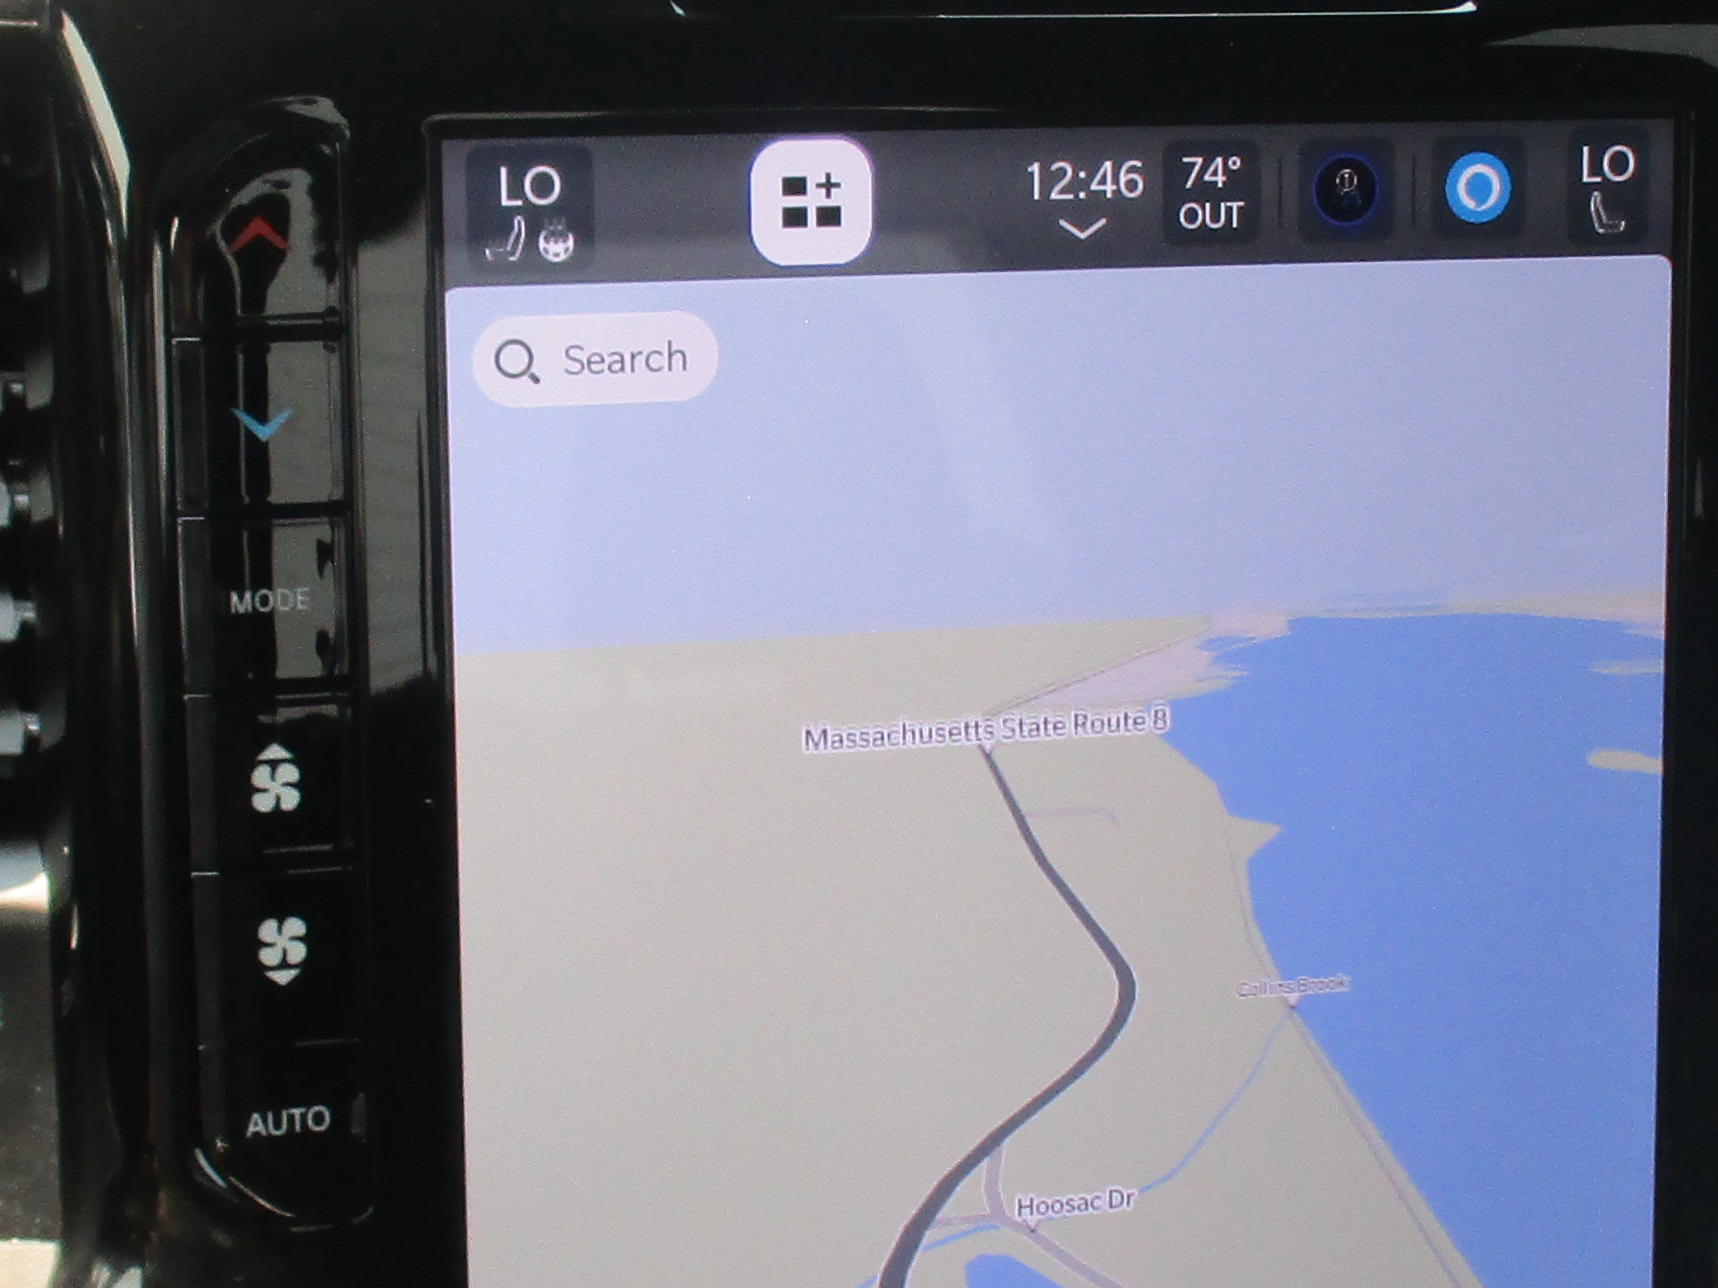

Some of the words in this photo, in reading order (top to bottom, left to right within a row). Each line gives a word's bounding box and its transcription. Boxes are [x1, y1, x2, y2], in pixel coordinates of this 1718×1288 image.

[1027, 158, 1145, 201] 12:46
[1182, 155, 1242, 189] 74°
[1581, 144, 1636, 184] LO
[499, 164, 561, 206] LO
[1178, 201, 1244, 230] OUT
[563, 340, 689, 377] Search
[230, 586, 311, 615] MODE
[804, 719, 994, 751] Massachusetts
[1001, 713, 1066, 740] State
[1073, 711, 1146, 736] Route
[245, 1105, 330, 1140] AUTO
[1017, 1194, 1103, 1217] Hoosac
[1109, 1189, 1136, 1209] Dr
